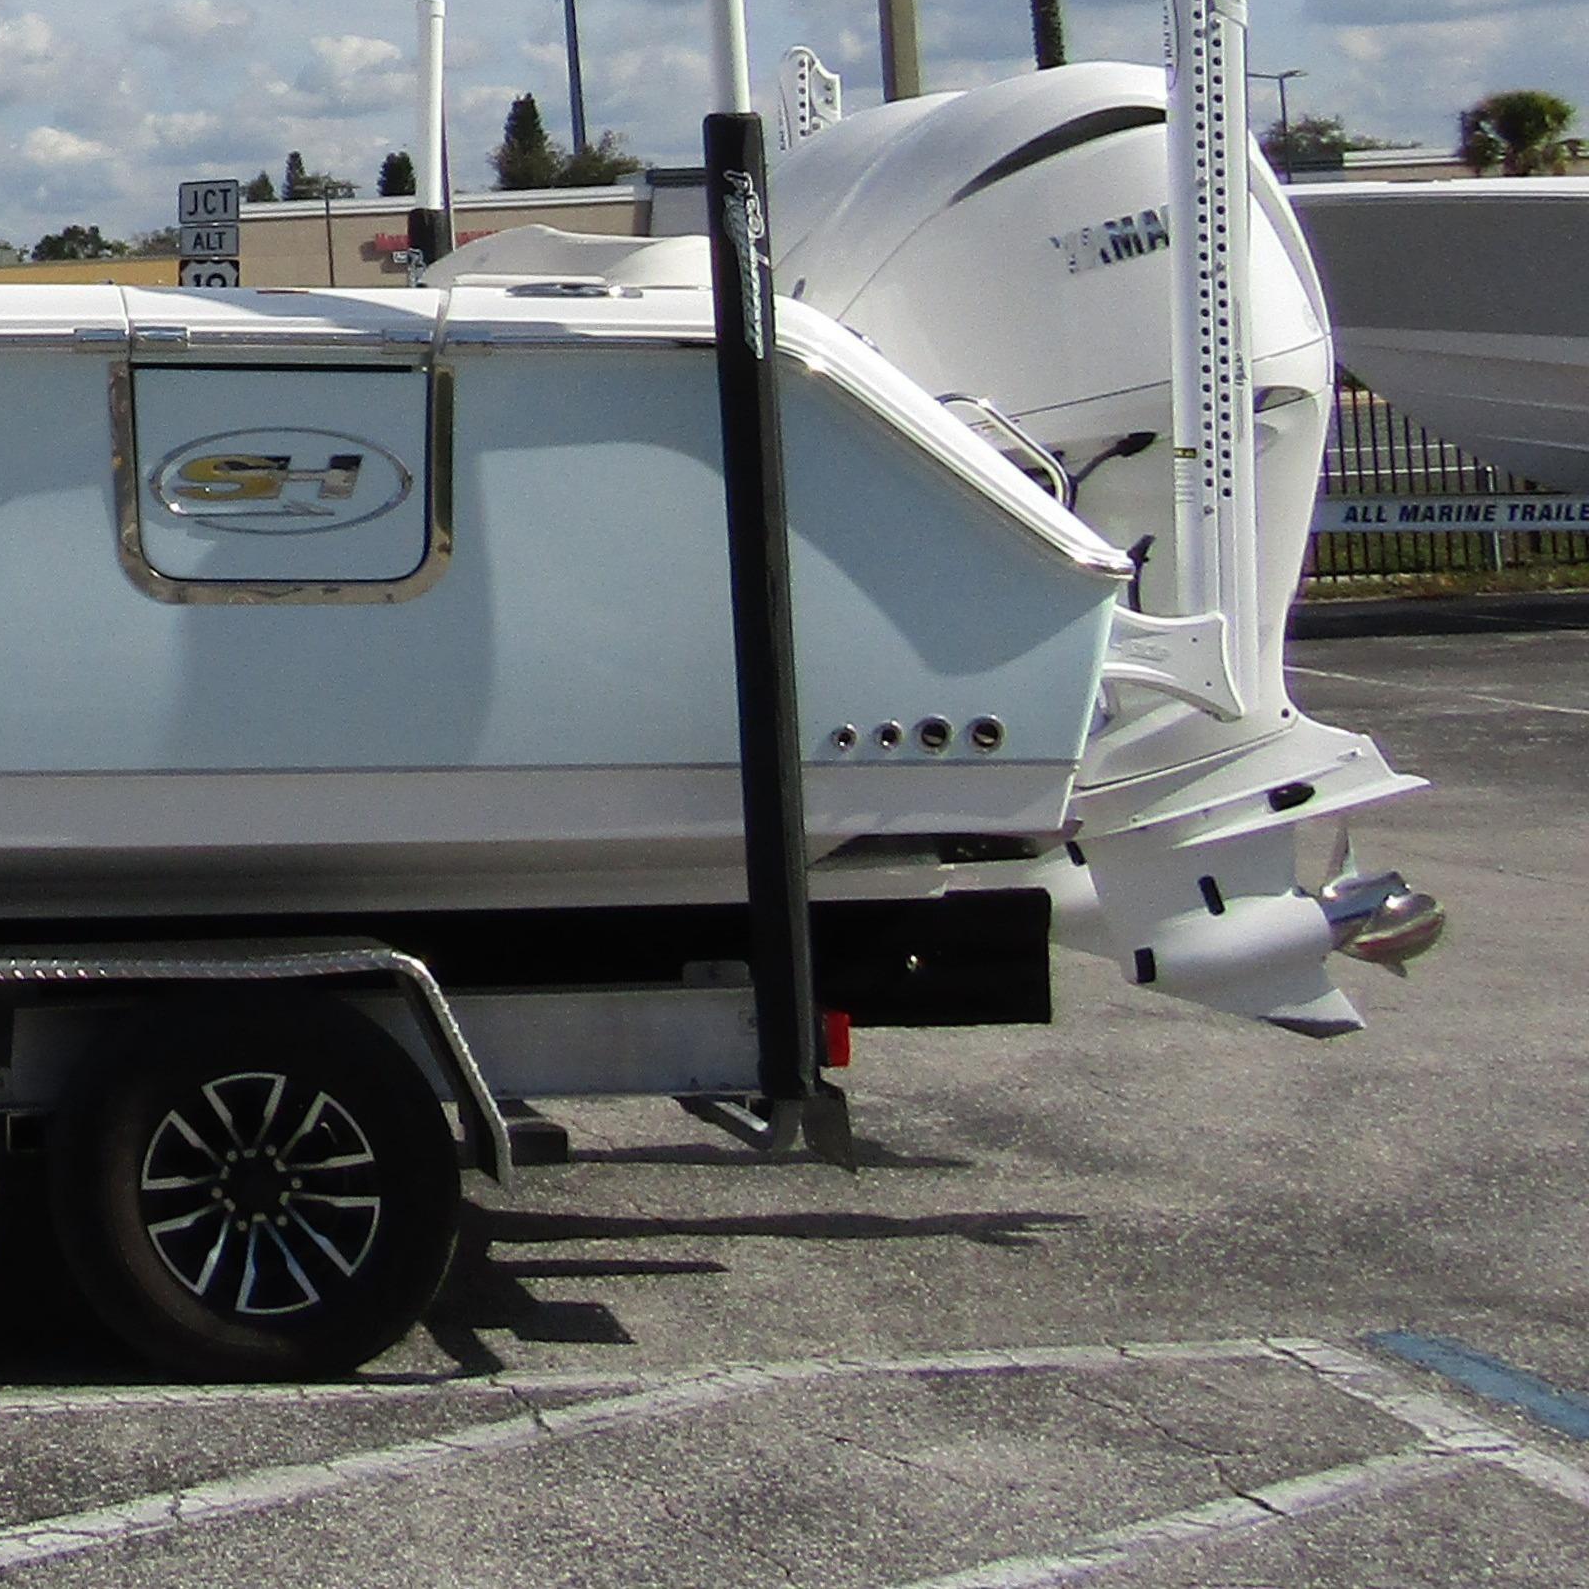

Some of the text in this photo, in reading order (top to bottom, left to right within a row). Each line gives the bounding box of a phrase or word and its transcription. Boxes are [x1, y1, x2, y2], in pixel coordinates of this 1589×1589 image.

[187, 188, 232, 216] JCT
[193, 231, 227, 251] ALT
[1049, 204, 1170, 274] YAMA
[1342, 504, 1388, 524] ALL
[1398, 503, 1498, 523] MARINE
